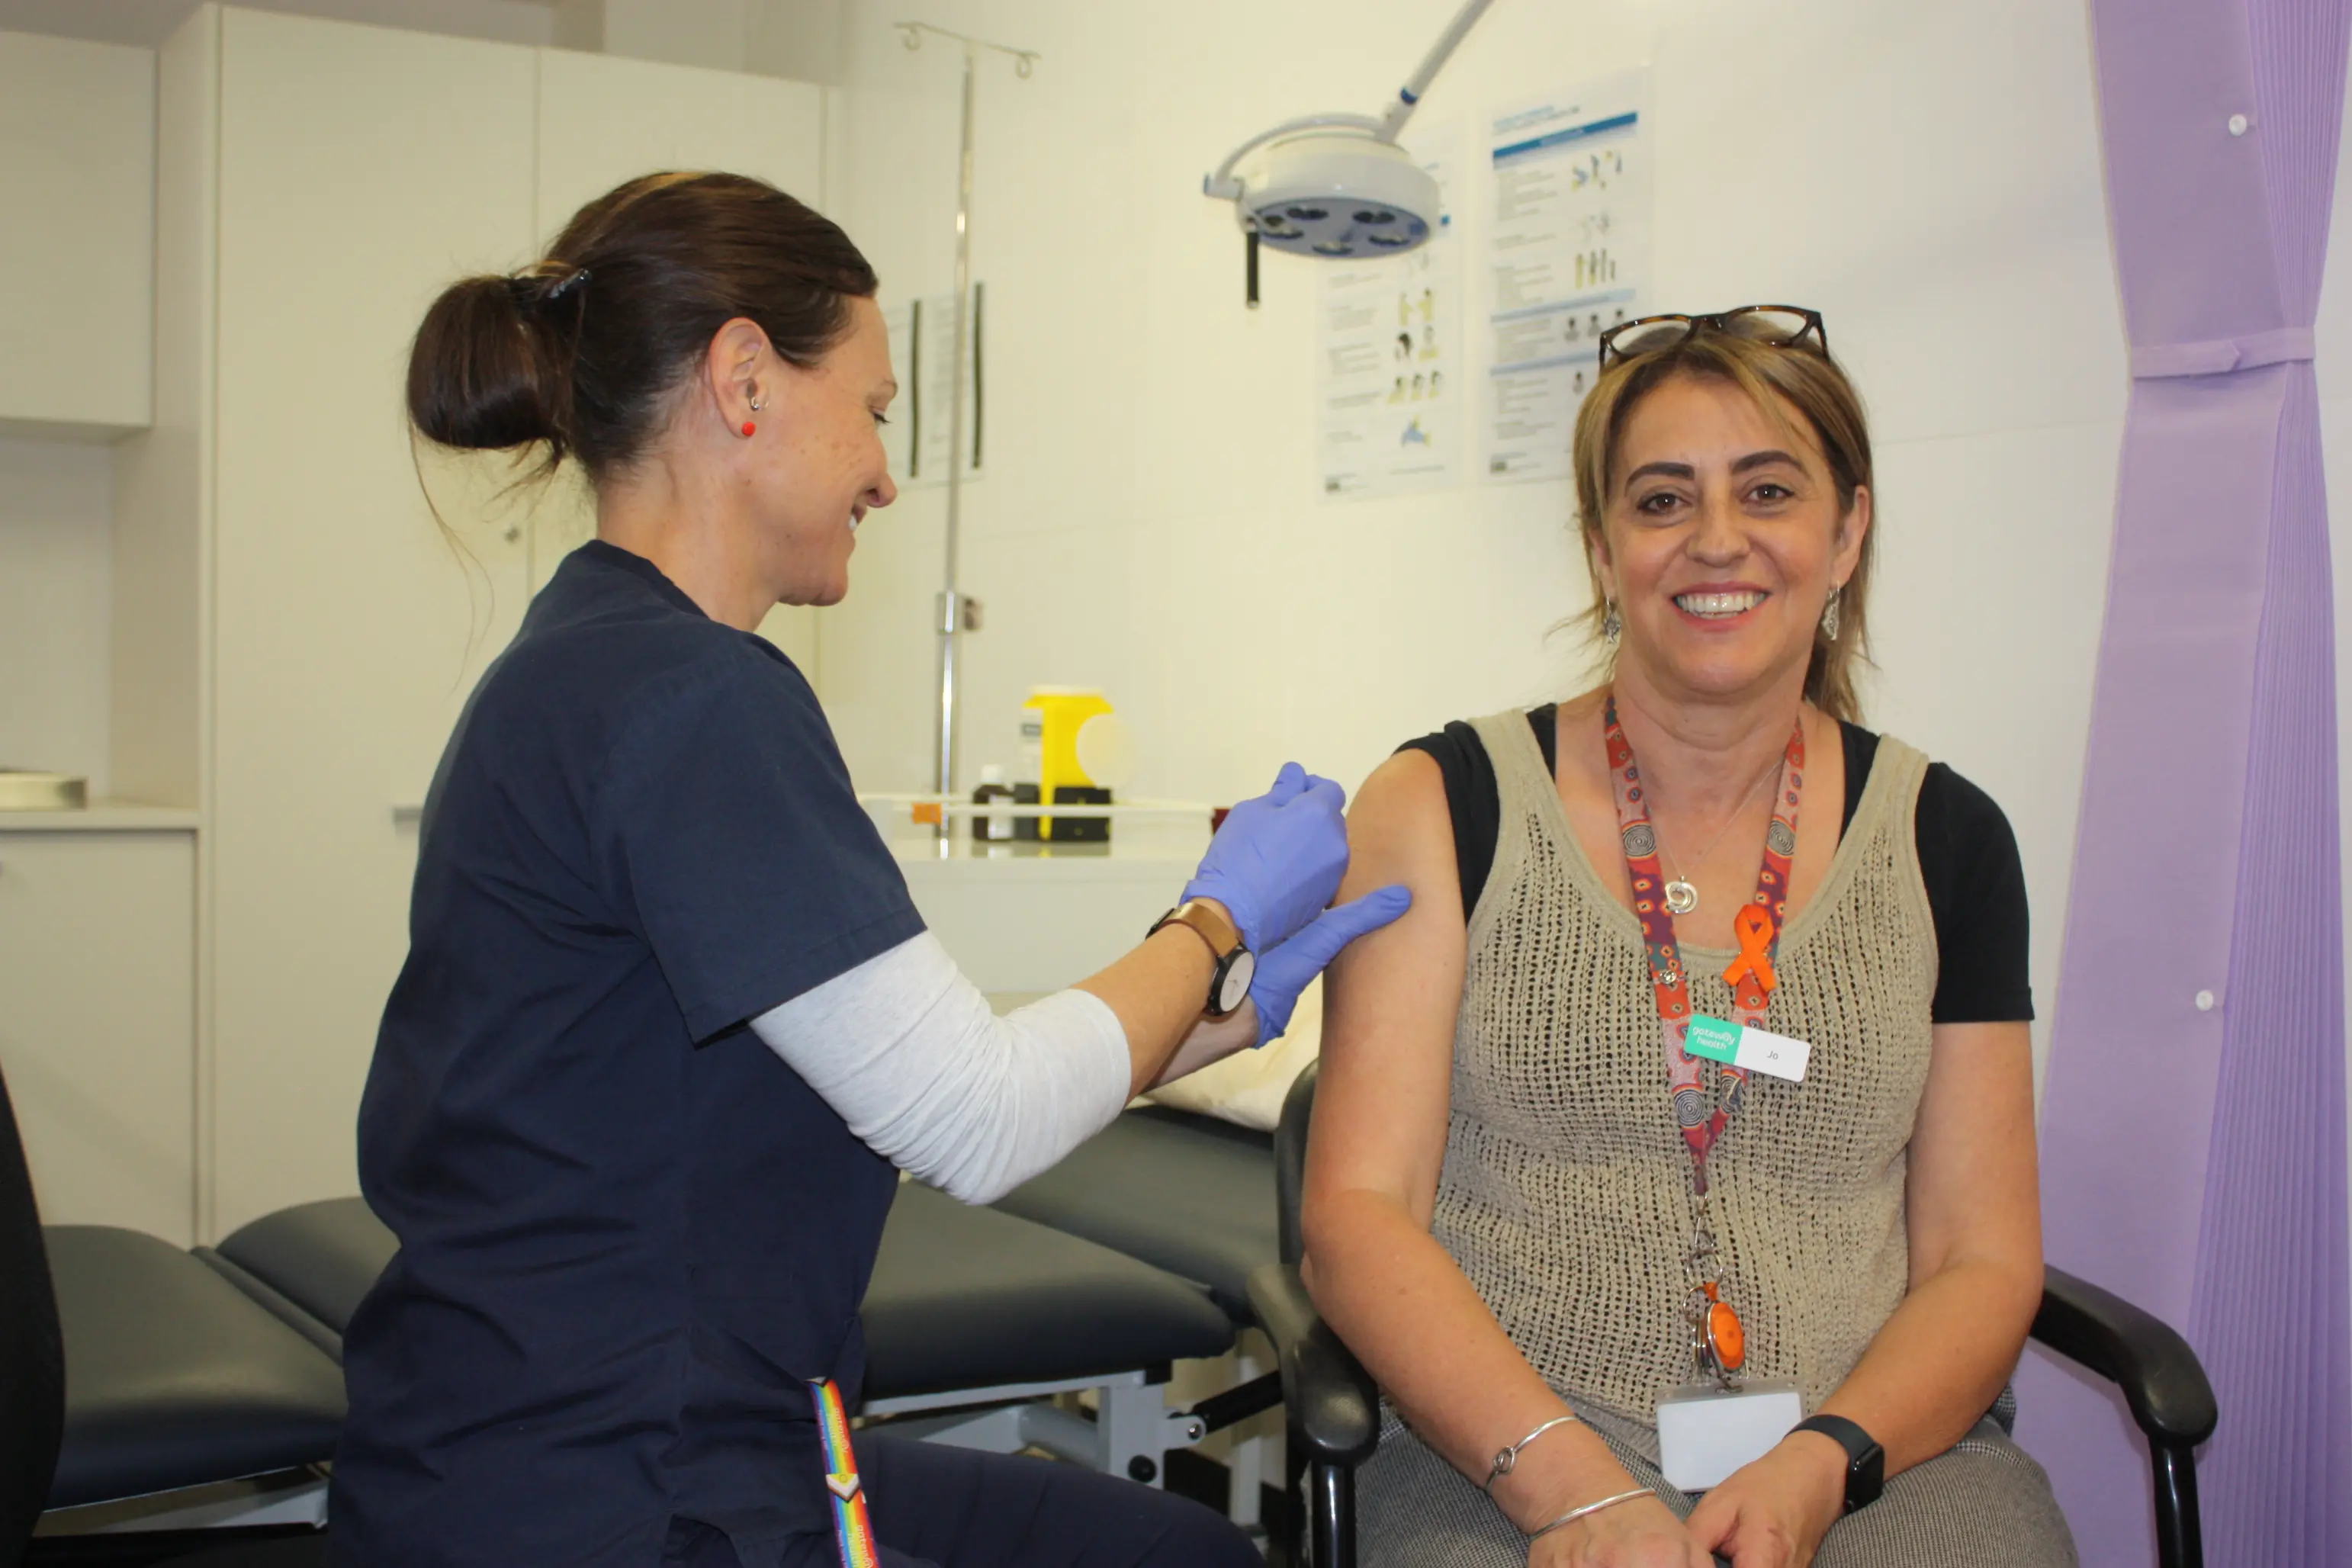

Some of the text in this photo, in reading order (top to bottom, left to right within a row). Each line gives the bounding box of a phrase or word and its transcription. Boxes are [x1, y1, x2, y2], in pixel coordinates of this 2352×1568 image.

[1692, 1027, 1736, 1046] gateway
[1697, 1035, 1728, 1051] health
[1767, 1050, 1779, 1060] Jo
